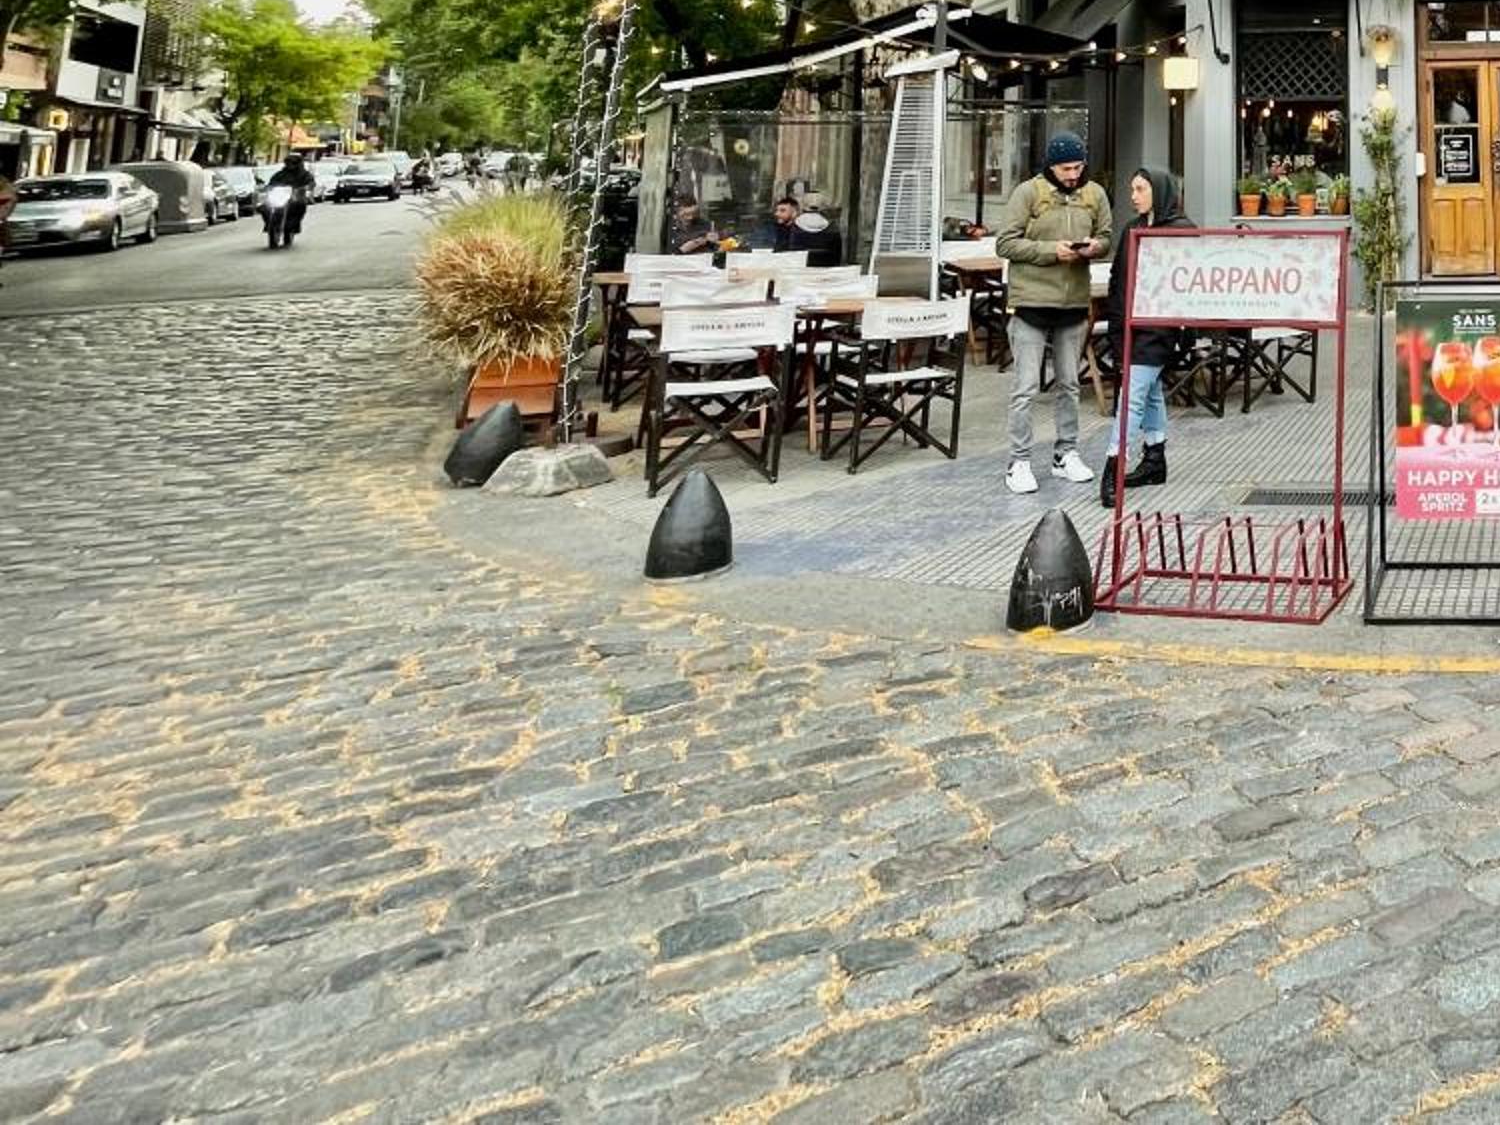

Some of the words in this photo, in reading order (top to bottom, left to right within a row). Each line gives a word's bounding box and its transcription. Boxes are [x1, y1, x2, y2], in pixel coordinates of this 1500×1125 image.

[1171, 266, 1302, 295] CARPANO
[1452, 314, 1497, 327] SANS
[1407, 470, 1477, 486] HAPPY
[1418, 493, 1468, 502] APEROL
[1482, 493, 1489, 504] 2
[1422, 502, 1465, 512] SPRITZ
